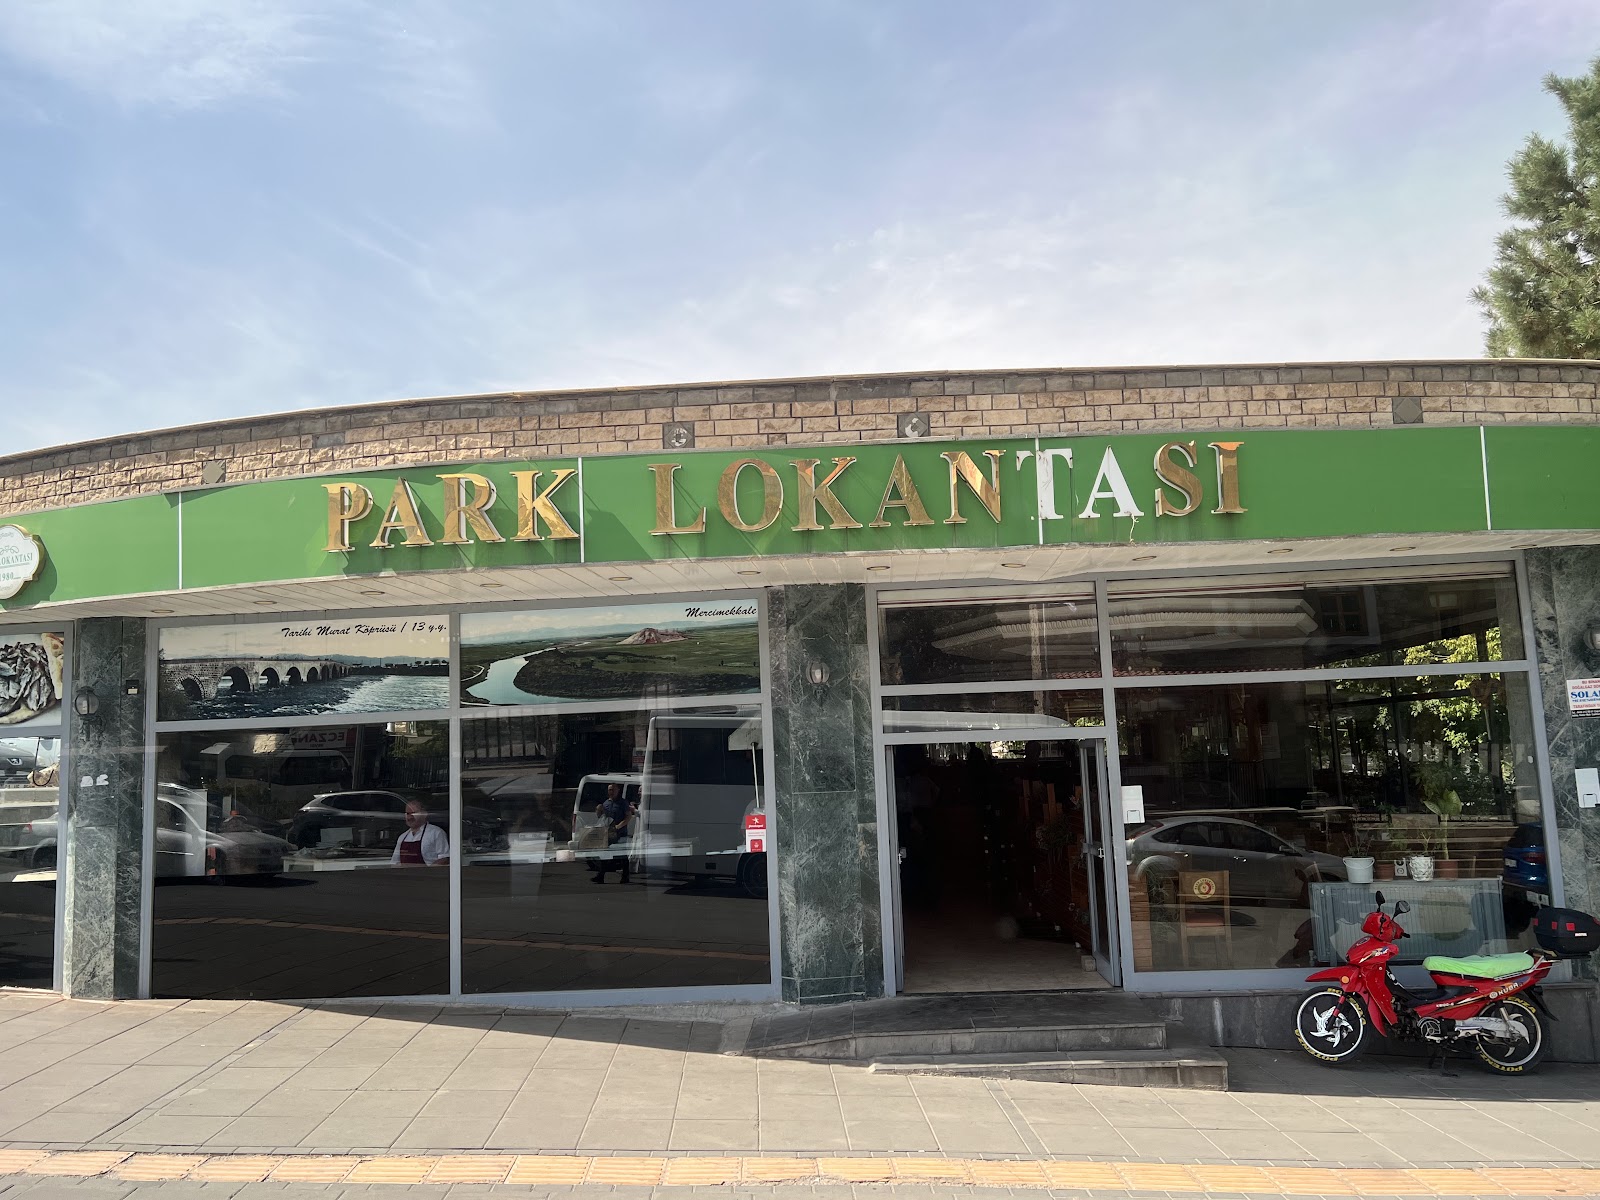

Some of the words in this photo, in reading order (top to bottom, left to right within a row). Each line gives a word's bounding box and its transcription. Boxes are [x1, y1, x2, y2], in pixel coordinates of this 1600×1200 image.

[321, 468, 579, 552] PARK
[648, 440, 1248, 536] LOKANTASI
[685, 606, 757, 618] Mercimekkale
[281, 627, 312, 637] Tarihi
[316, 626, 350, 636] Murat
[355, 623, 396, 634] Köprüsü
[411, 622, 425, 632] 13
[1570, 690, 1600, 699] SOLA
[1498, 982, 1519, 996] KUBA
